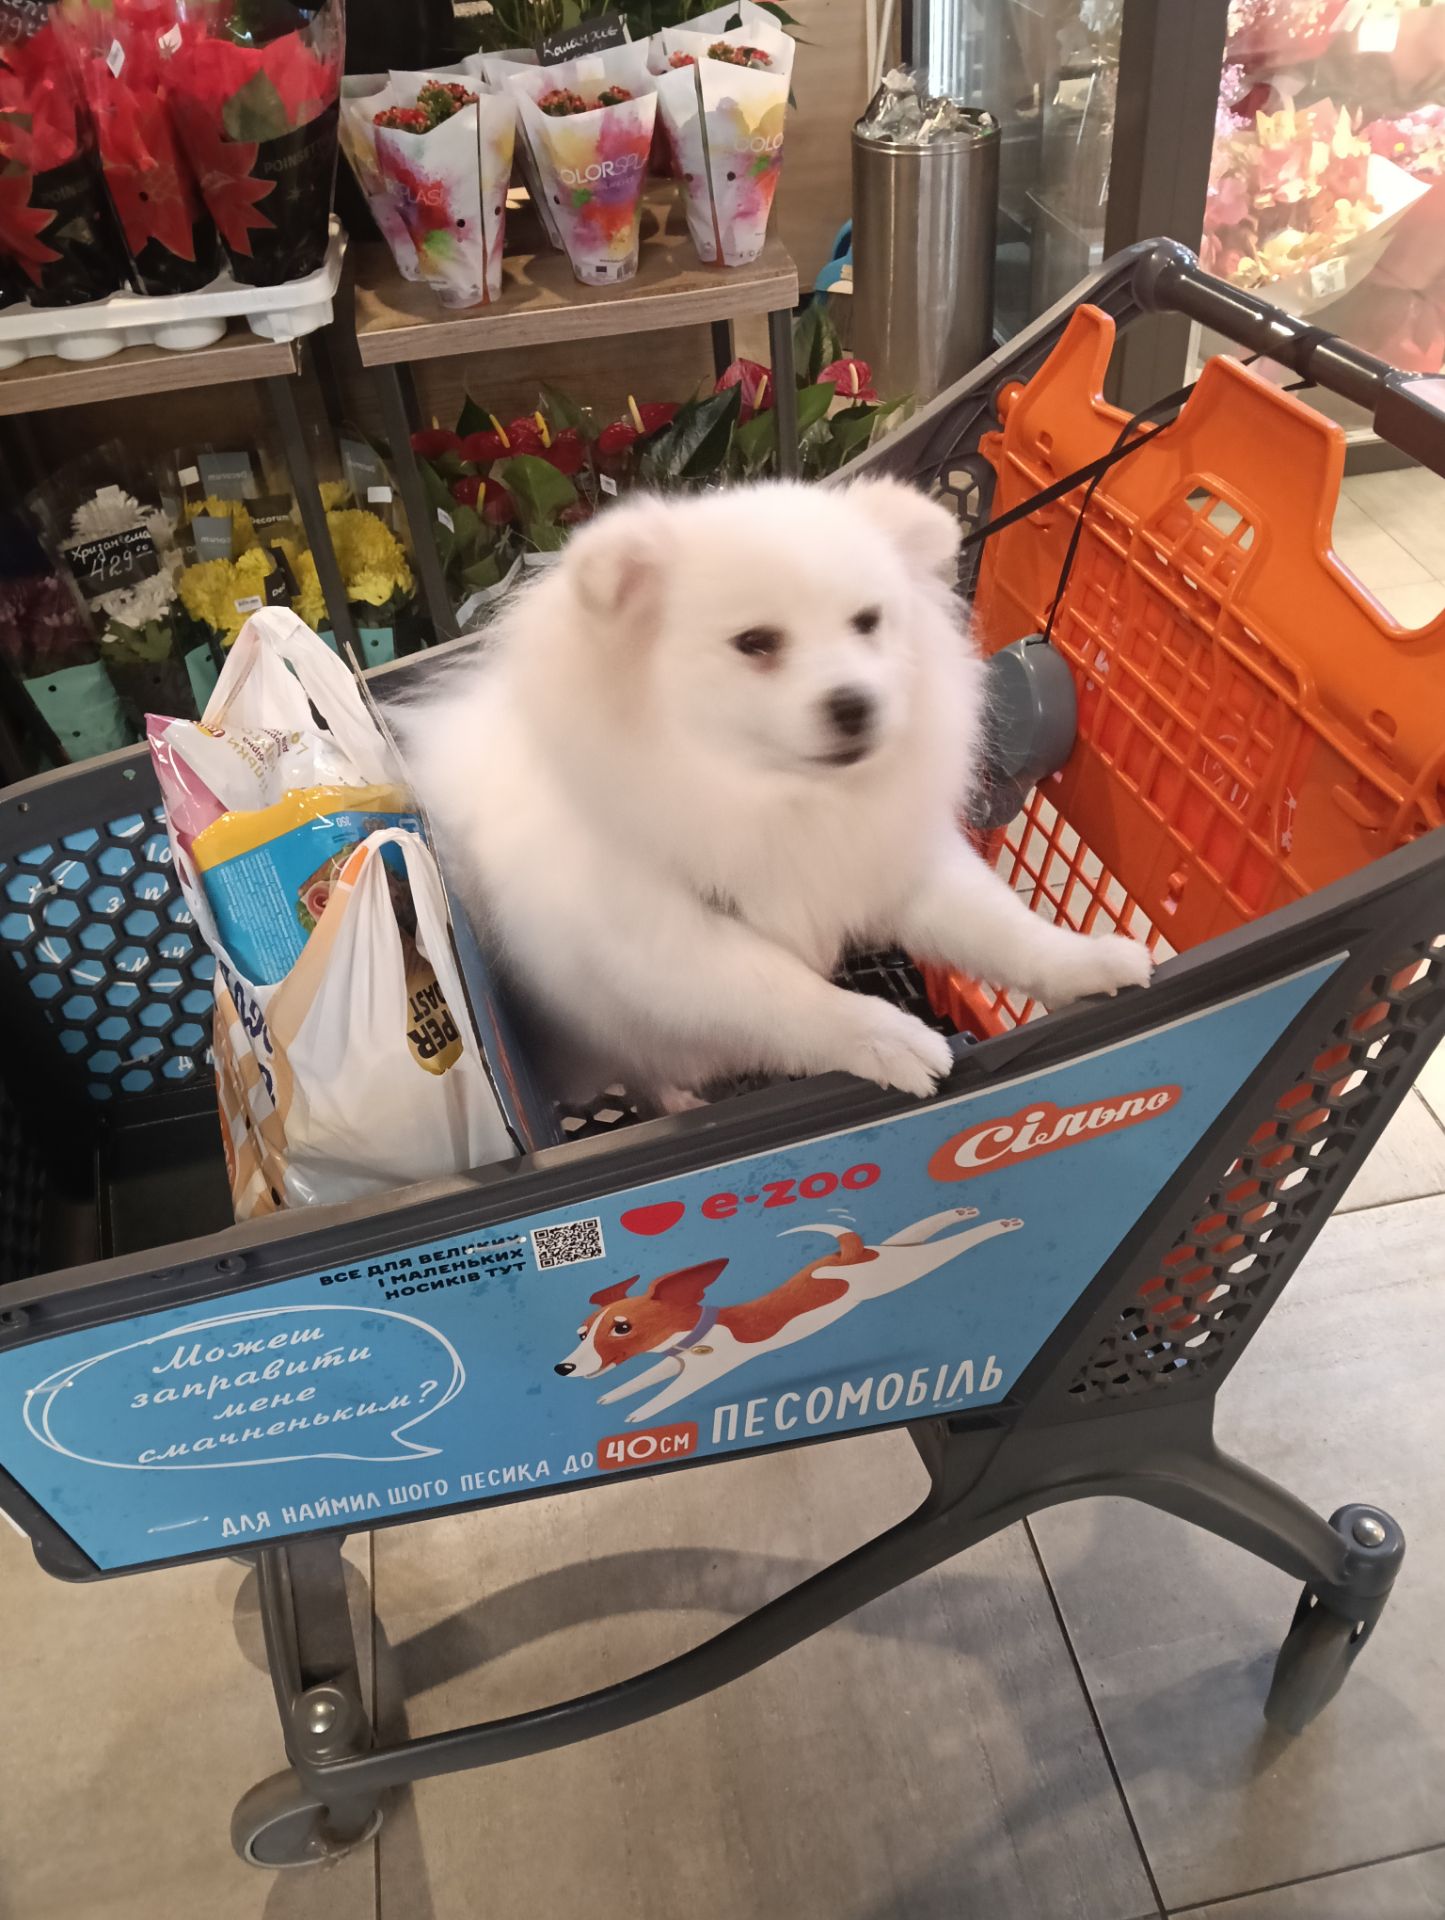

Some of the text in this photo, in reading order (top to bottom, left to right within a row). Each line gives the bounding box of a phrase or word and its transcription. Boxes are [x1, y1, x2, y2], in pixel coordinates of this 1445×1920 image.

[319, 1269, 362, 1287] ВСЕ
[367, 1257, 412, 1277] ДЛЯ
[385, 1261, 526, 1300] НОСИКІВ ТУТ
[391, 1248, 524, 1285] МАЛЕНЬКИХ
[152, 1327, 324, 1374] Можеш
[130, 1346, 371, 1409] заправити
[213, 1386, 316, 1420] мене
[711, 1356, 1002, 1444] ПЕСОМОБІЛЬ
[221, 1511, 271, 1538] ДЛЯ
[460, 1460, 550, 1493] ПЕСИКА
[563, 1451, 594, 1476] ДО
